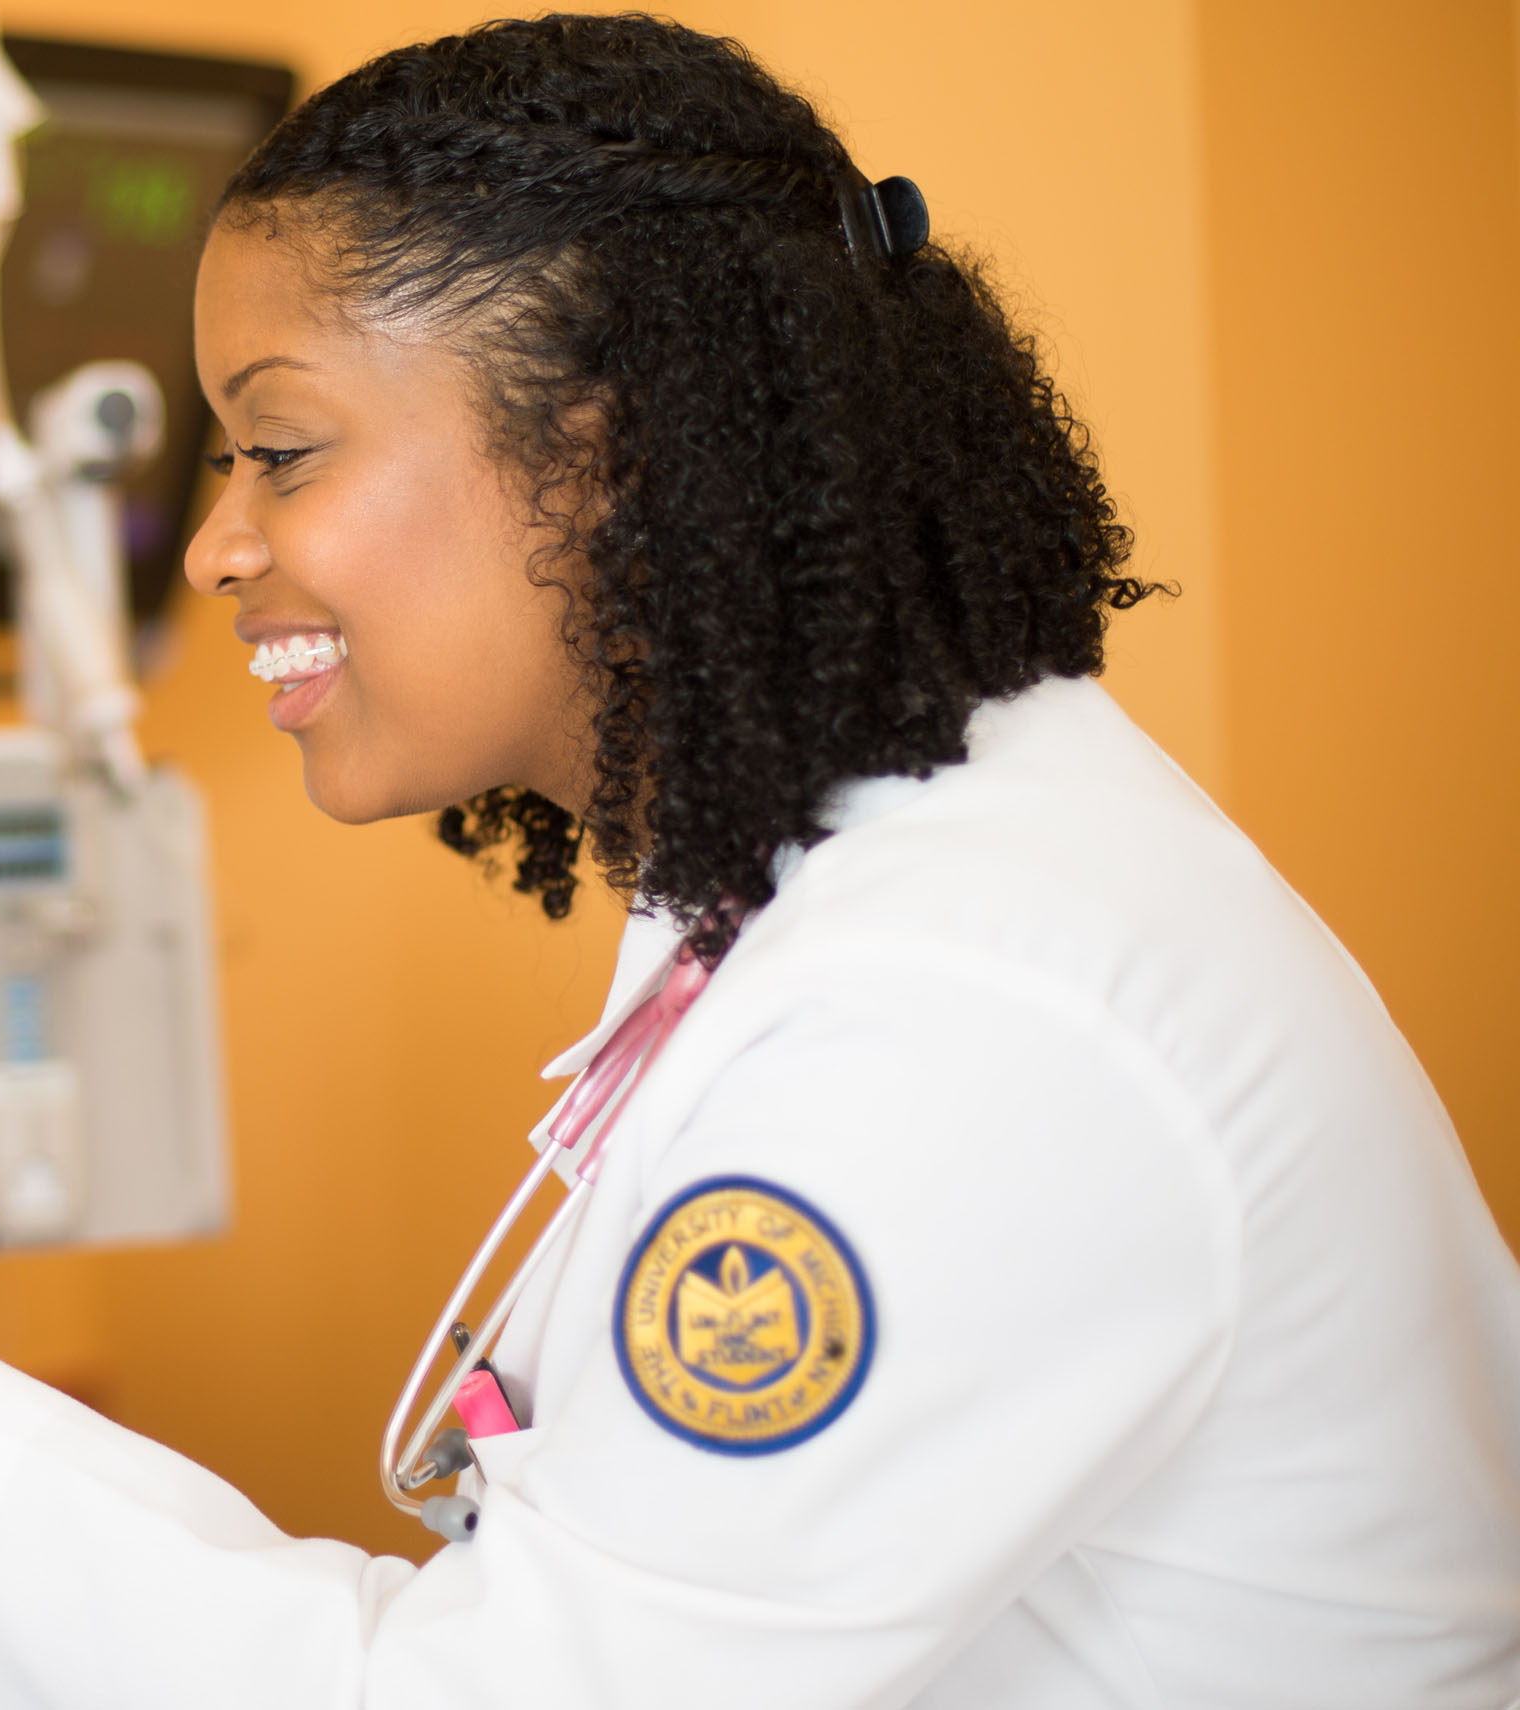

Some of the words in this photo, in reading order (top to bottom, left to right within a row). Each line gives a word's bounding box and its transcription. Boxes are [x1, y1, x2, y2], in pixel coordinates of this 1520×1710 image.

[756, 1215, 795, 1241] OF
[638, 1204, 743, 1325] UNIVERSITY
[641, 1340, 679, 1401] THE
[705, 1398, 788, 1425] FLINT
